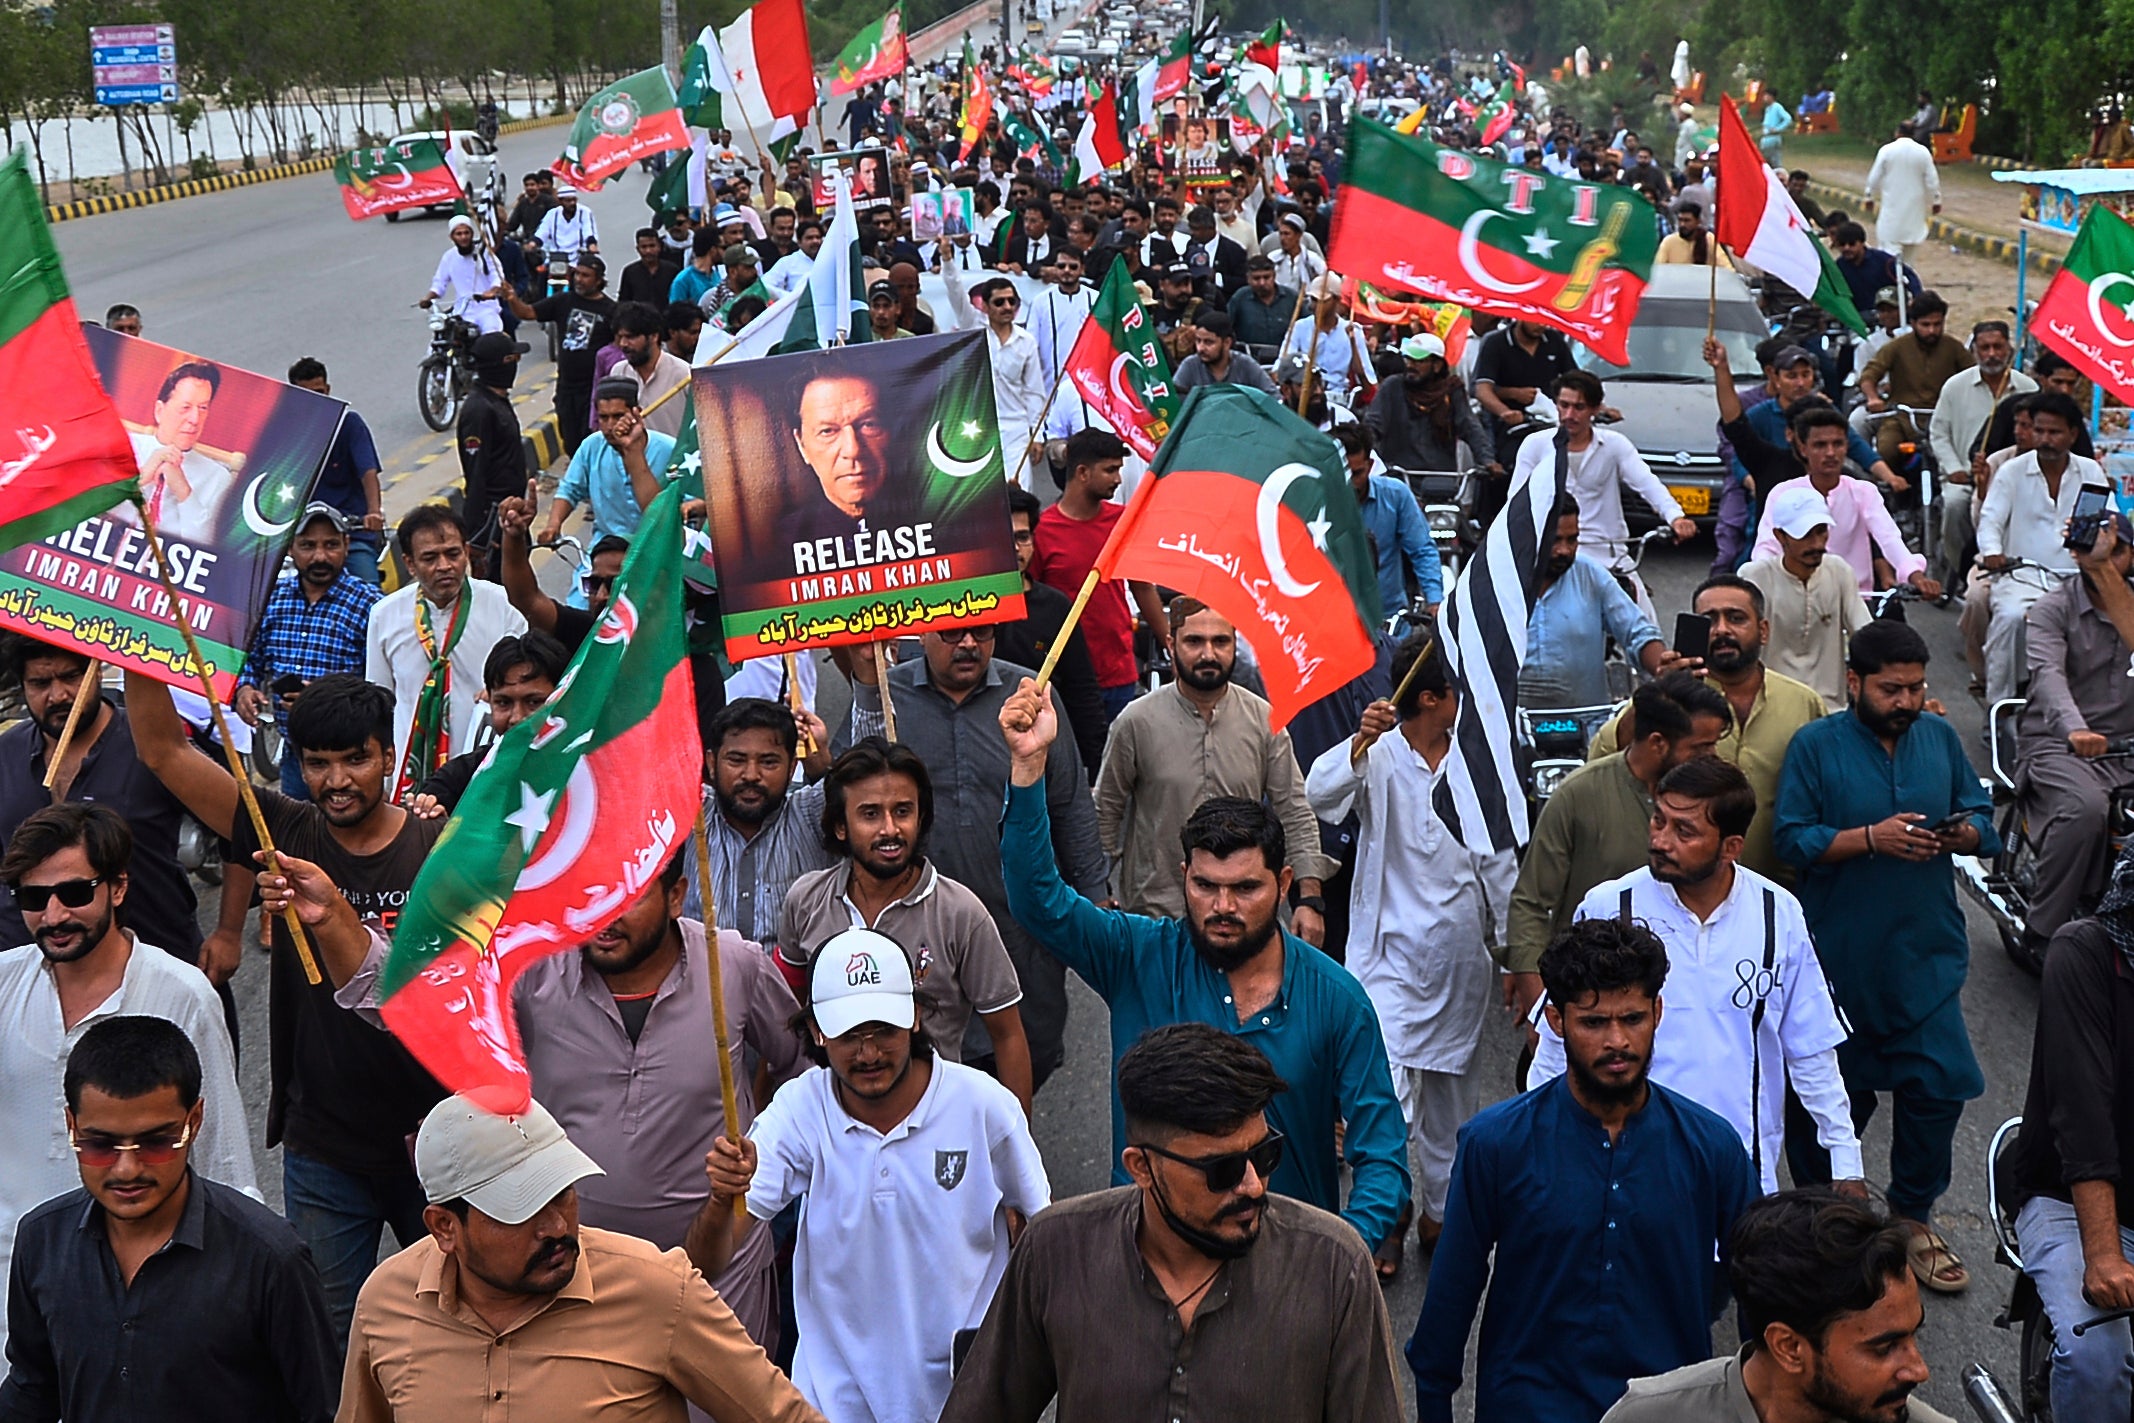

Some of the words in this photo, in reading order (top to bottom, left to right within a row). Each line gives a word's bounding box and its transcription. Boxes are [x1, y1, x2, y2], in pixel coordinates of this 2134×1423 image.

[2049, 318, 2102, 364] انصاف
[792, 522, 937, 575] RELEASE
[1157, 533, 1241, 579] انصاف
[24, 549, 121, 601] IMRAN
[790, 573, 873, 602] IMRAN
[884, 558, 951, 588] KHAN
[847, 602, 890, 635] ٹاؤن
[887, 597, 953, 628] سرفراز
[953, 592, 998, 617] میاں
[847, 971, 882, 986] UAE
[1731, 958, 1784, 1010] 804
